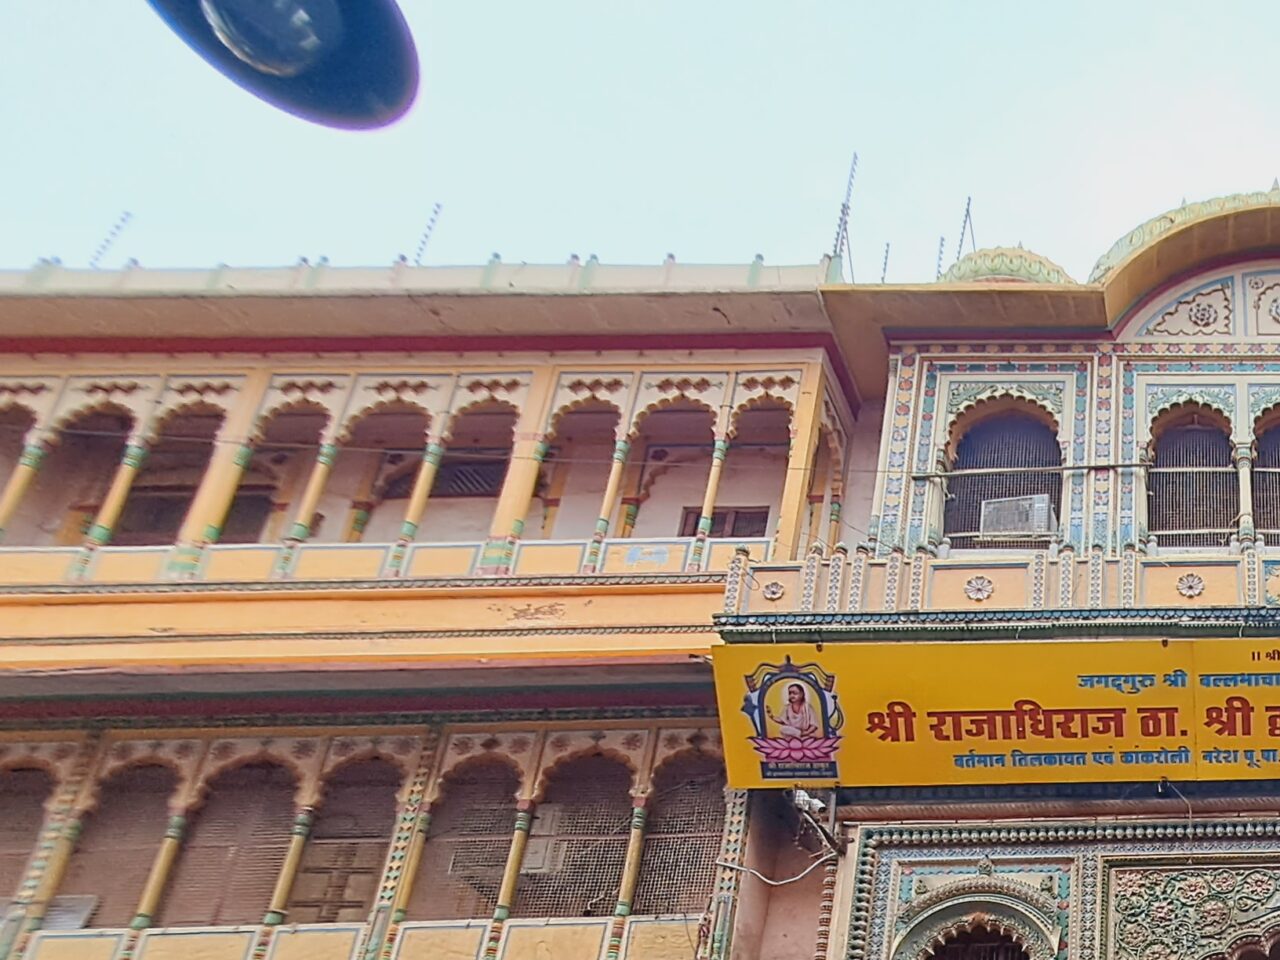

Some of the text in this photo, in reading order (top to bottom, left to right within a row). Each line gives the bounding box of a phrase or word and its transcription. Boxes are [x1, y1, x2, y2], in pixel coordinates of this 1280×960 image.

[1265, 649, 1280, 661] श्री
[1077, 674, 1156, 694] जगद्गुरु
[1162, 669, 1187, 688] श्री
[866, 701, 916, 742] श्री
[927, 700, 1126, 741] राजाधिराज
[1137, 707, 1188, 737] ठा.
[1203, 696, 1254, 737] श्री
[953, 749, 1006, 768] वर्तमान
[1092, 745, 1114, 765] एवं
[1201, 747, 1239, 763] नरेश
